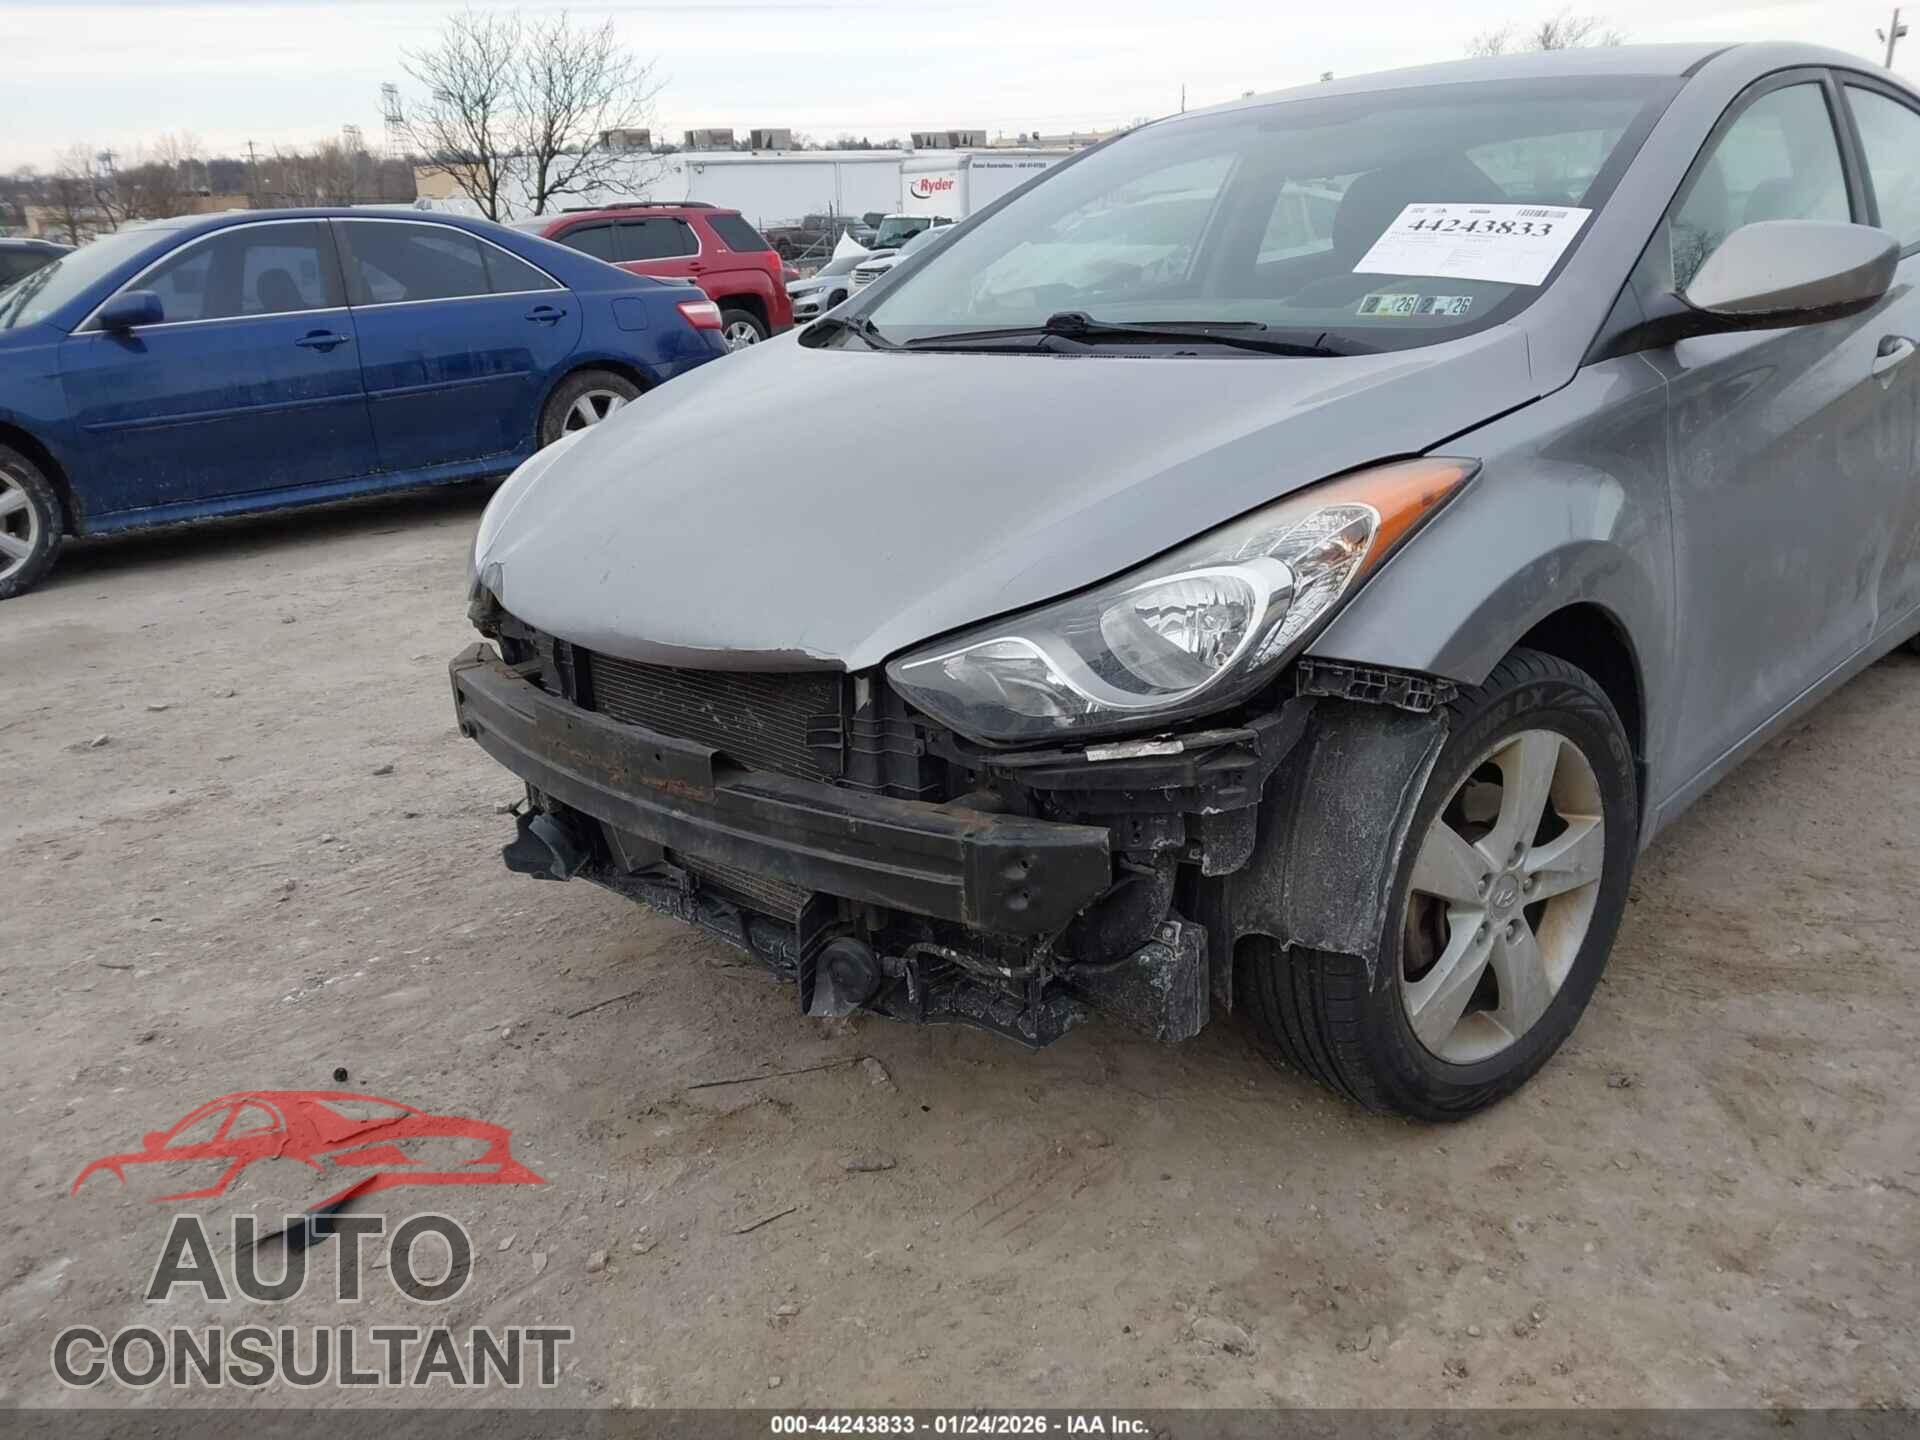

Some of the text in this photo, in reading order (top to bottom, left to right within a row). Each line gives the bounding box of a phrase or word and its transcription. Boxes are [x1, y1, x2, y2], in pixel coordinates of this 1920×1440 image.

[920, 178, 954, 194] Ryder
[1408, 218, 1553, 237] 44243833
[1453, 297, 1470, 313] 26
